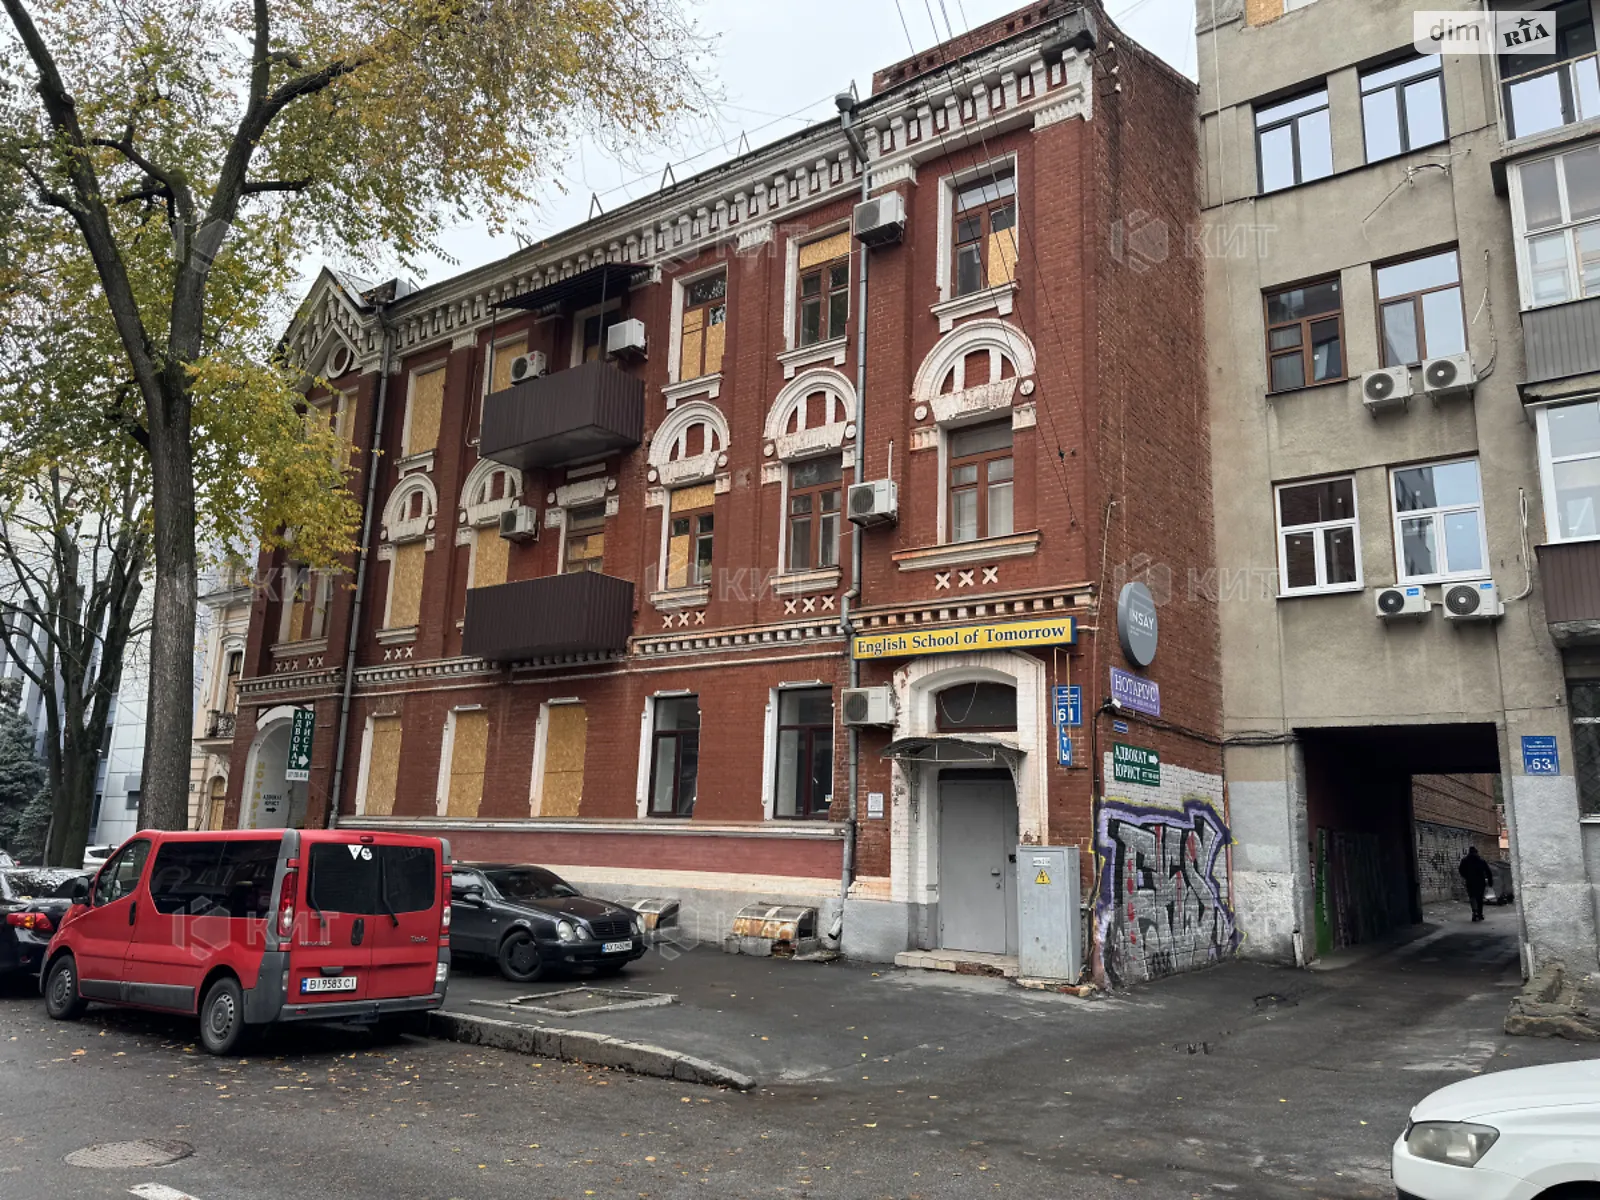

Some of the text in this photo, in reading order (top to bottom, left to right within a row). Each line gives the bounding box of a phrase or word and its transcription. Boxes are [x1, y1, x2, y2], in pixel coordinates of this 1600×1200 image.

[1129, 607, 1154, 630] INSAY
[857, 626, 1066, 656] English School of Tomorrow
[1058, 708, 1074, 721] 61
[291, 711, 303, 768] АДВОКАТ
[302, 711, 314, 753] ЮРИСТ
[1115, 745, 1147, 764] АДВОКАТ
[1532, 758, 1551, 770] 63
[1115, 763, 1140, 780] ЮРИСТ
